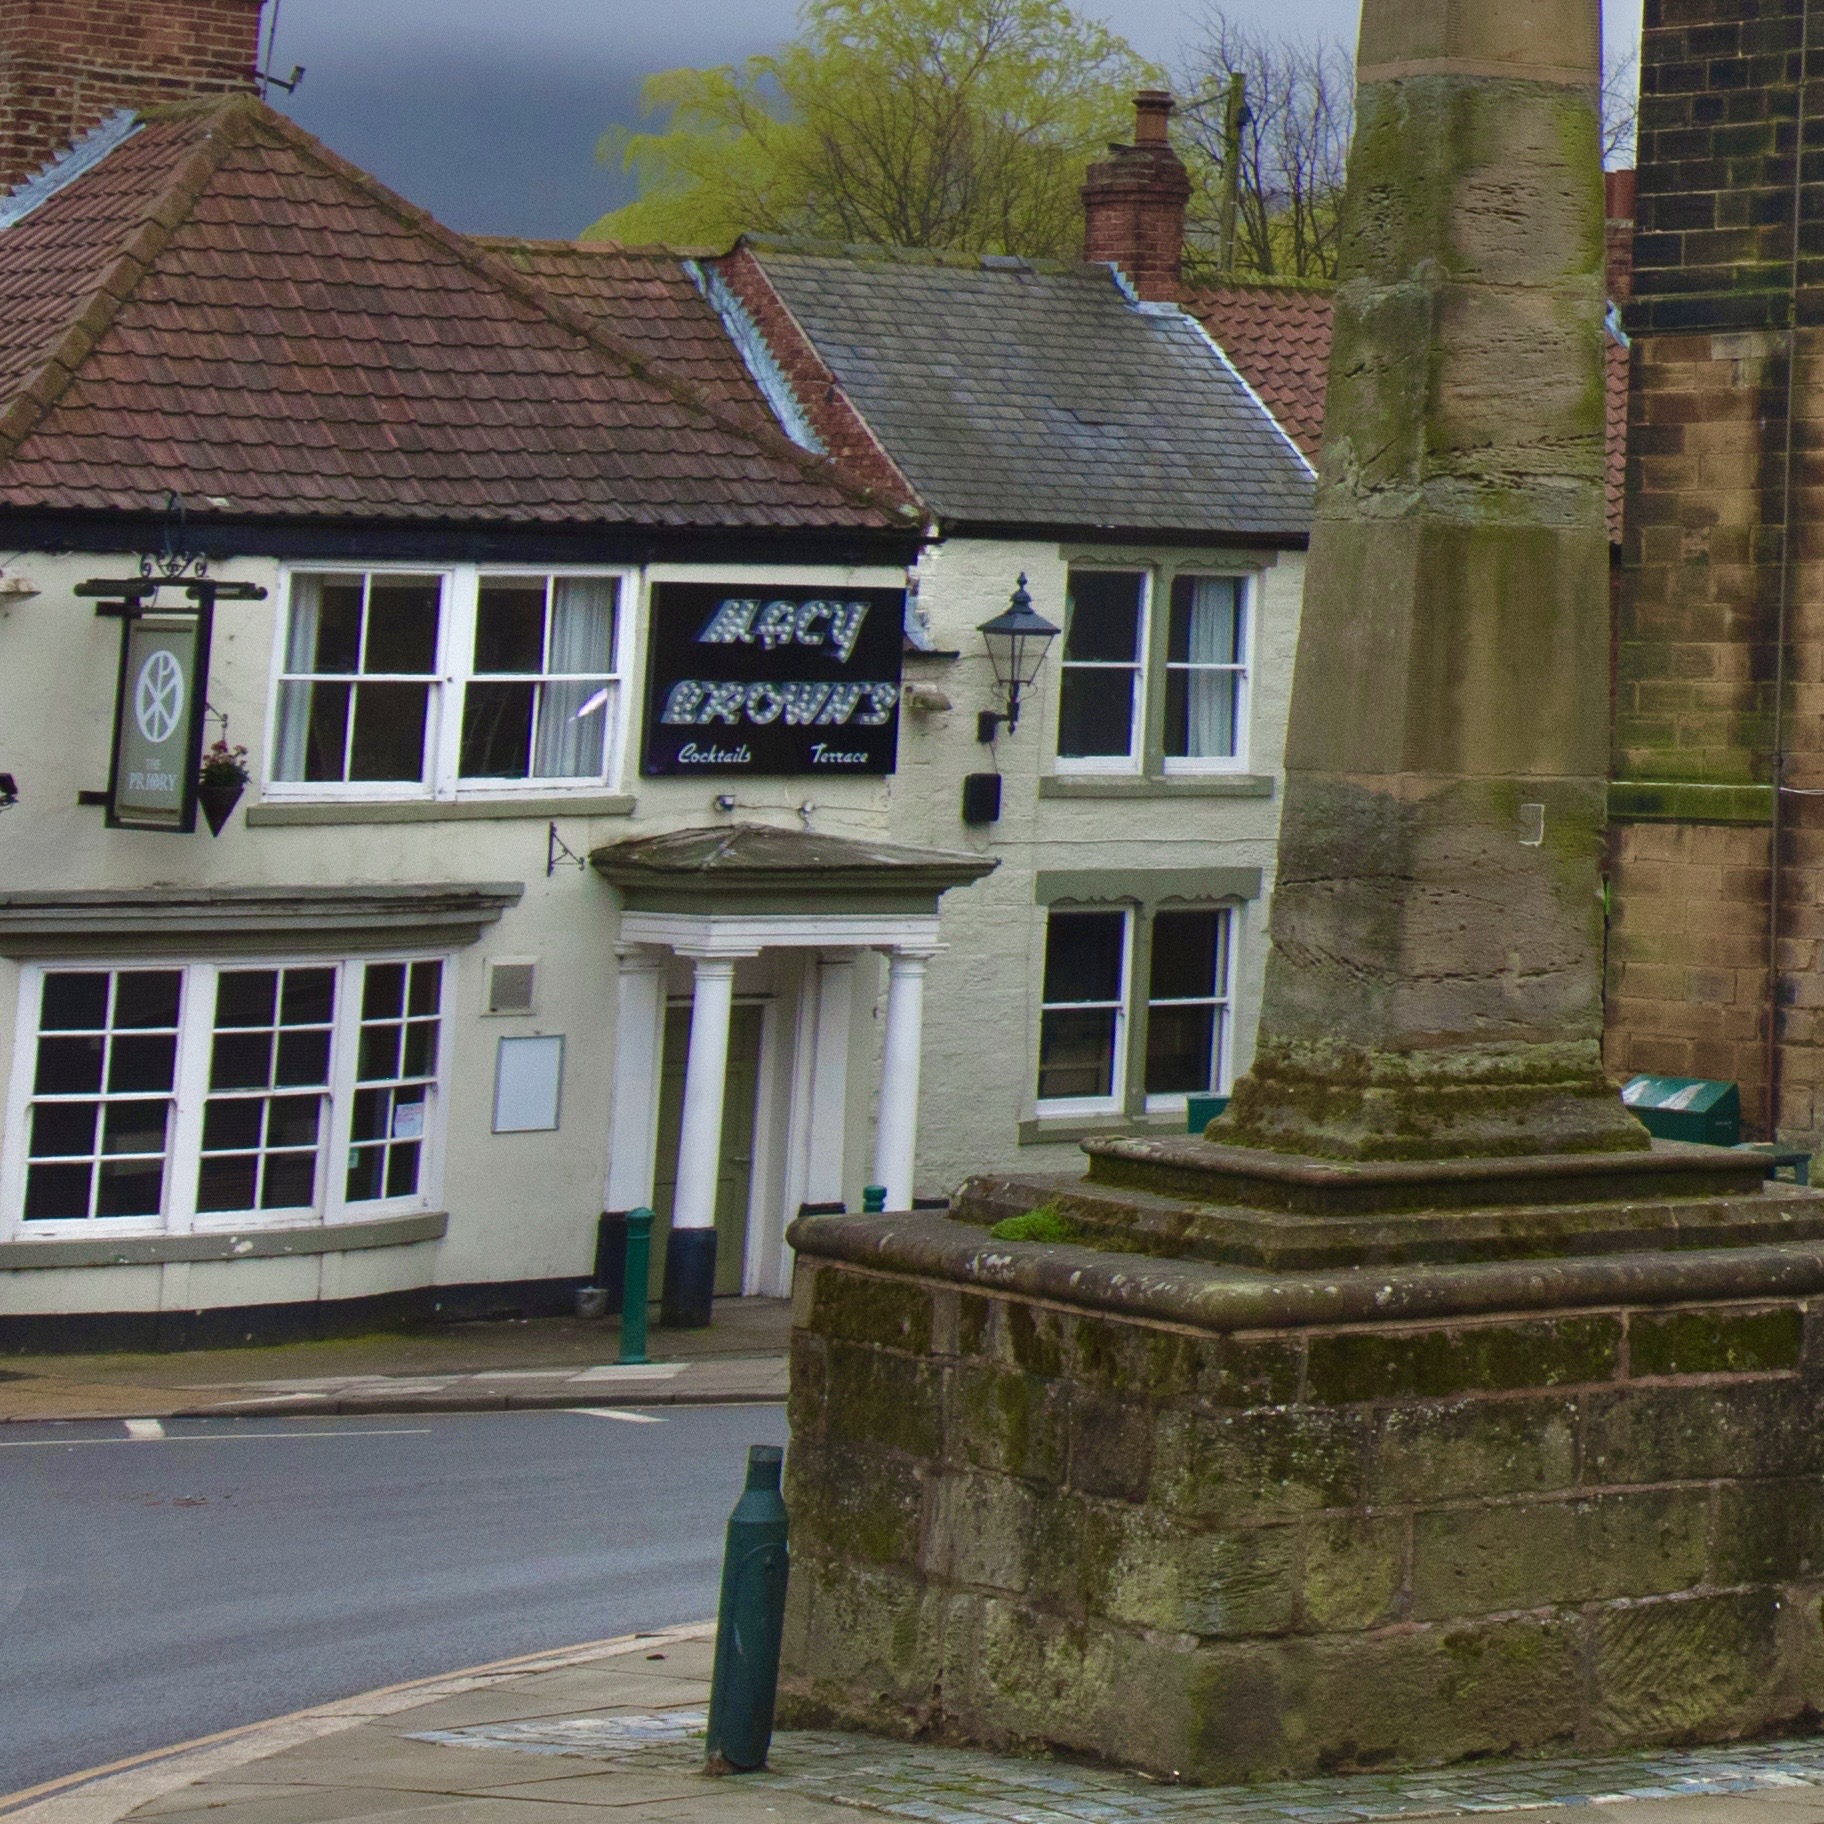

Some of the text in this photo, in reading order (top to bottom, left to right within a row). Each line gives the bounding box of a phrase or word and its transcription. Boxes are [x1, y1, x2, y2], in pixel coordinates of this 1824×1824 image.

[695, 599, 872, 663] MACY
[678, 743, 869, 764] Cocktails Terrace
